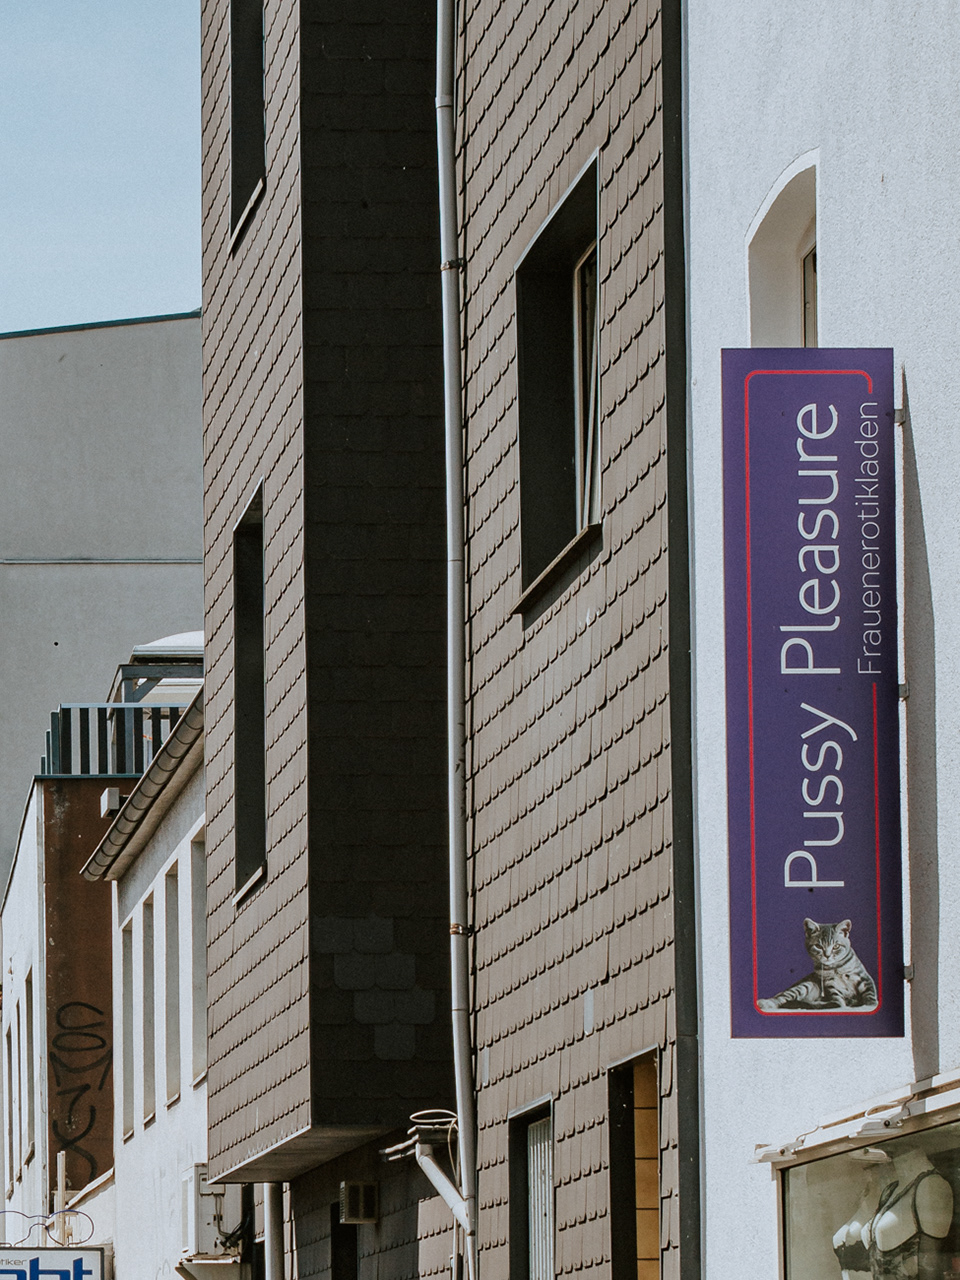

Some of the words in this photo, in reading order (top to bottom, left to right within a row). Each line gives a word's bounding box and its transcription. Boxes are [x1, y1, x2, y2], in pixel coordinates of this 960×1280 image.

[779, 402, 841, 675] Pleasure
[854, 401, 882, 675] Frauenerotikladen
[784, 702, 858, 888] Pussy
